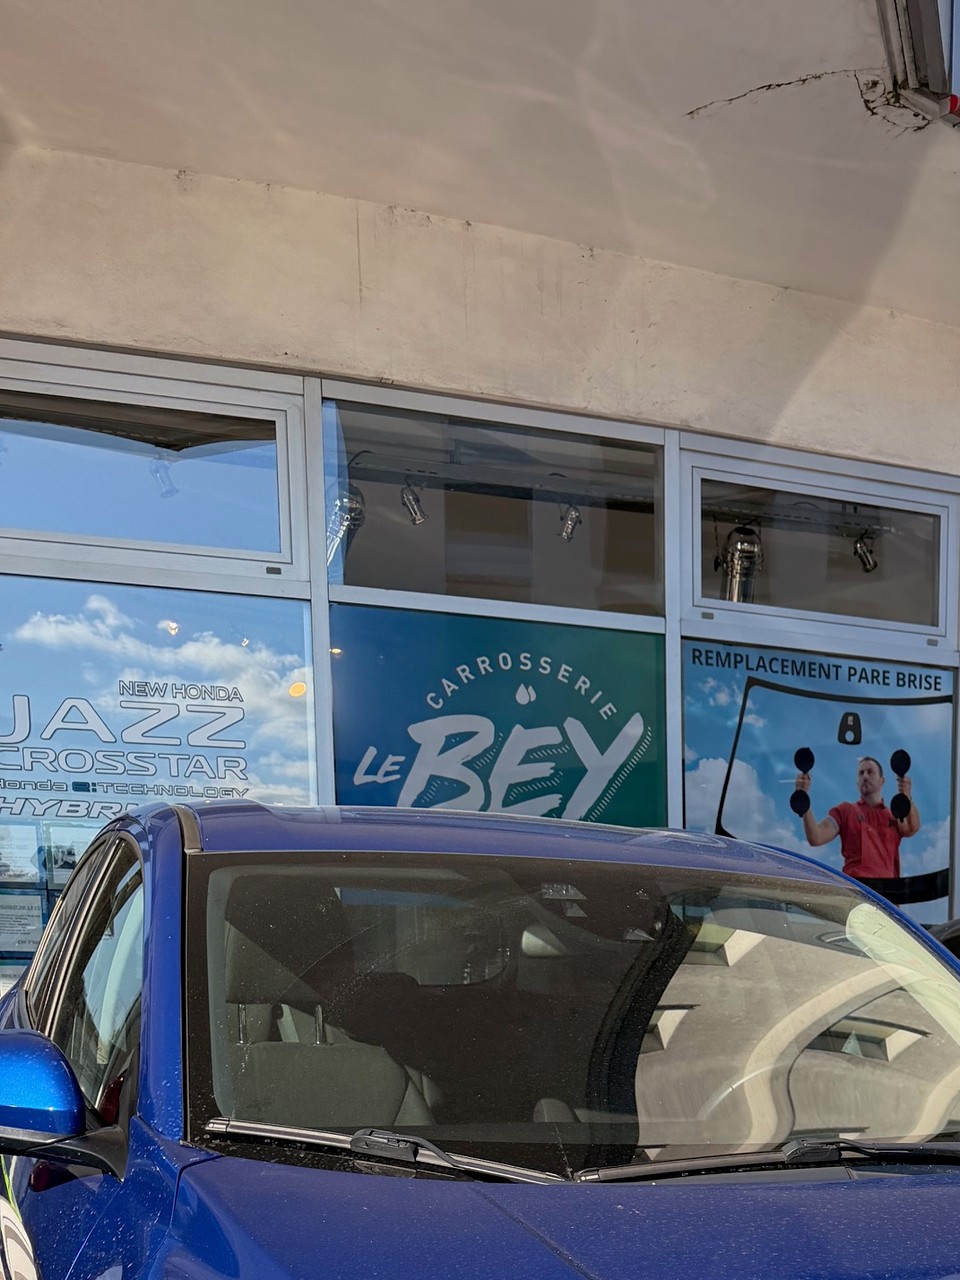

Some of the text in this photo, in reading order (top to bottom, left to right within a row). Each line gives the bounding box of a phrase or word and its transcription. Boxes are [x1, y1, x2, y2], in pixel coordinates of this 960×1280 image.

[118, 680, 244, 702] NEW HONDA
[426, 652, 617, 721] CARROSSERIE
[691, 648, 942, 692] REMPLACEMENT PARE BRISE
[0, 694, 247, 749] JAZZ
[353, 711, 647, 821] LE BEY
[0, 797, 138, 820] HYBR
